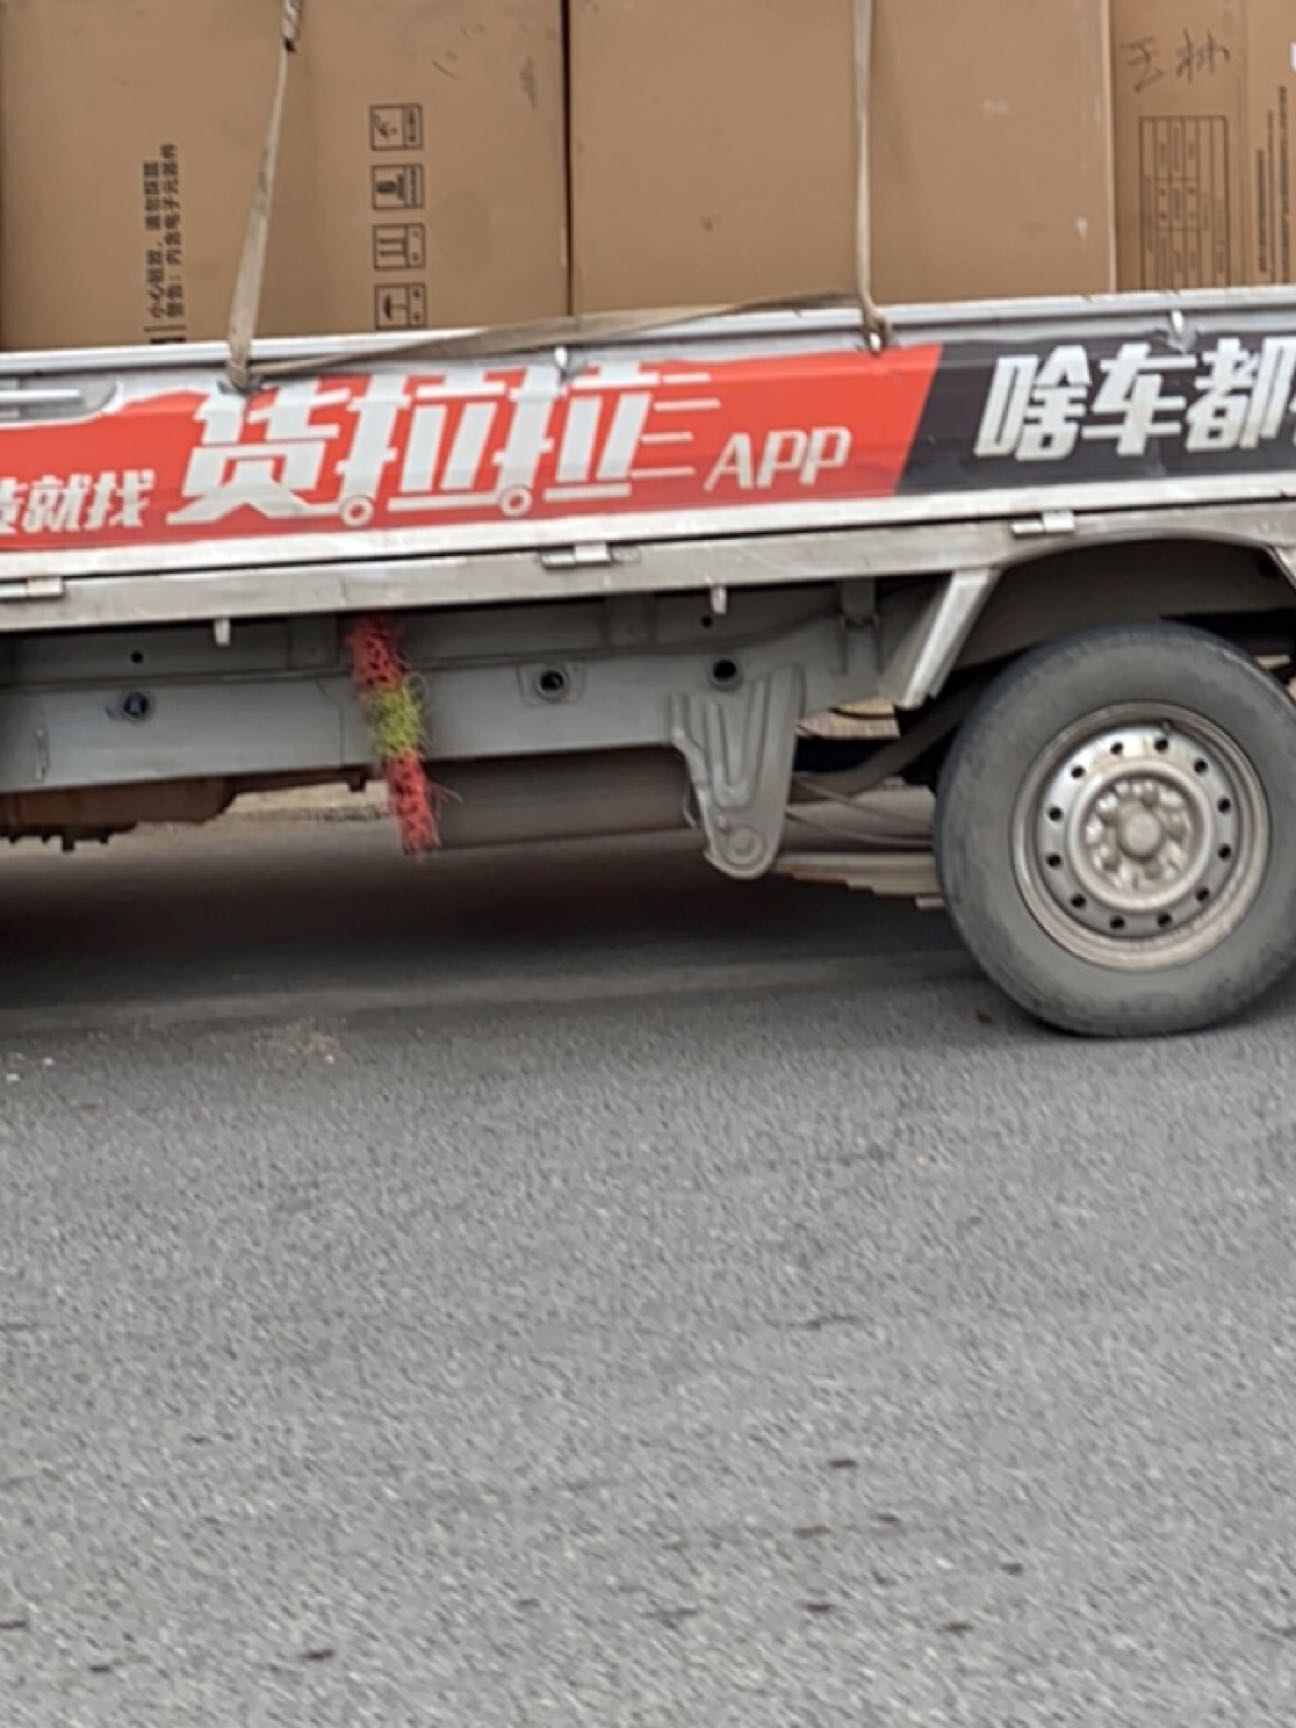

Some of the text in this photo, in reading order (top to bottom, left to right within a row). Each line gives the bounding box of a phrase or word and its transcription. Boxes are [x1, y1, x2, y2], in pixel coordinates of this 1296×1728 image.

[167, 361, 664, 528] 货拉拉
[704, 426, 853, 494] APP
